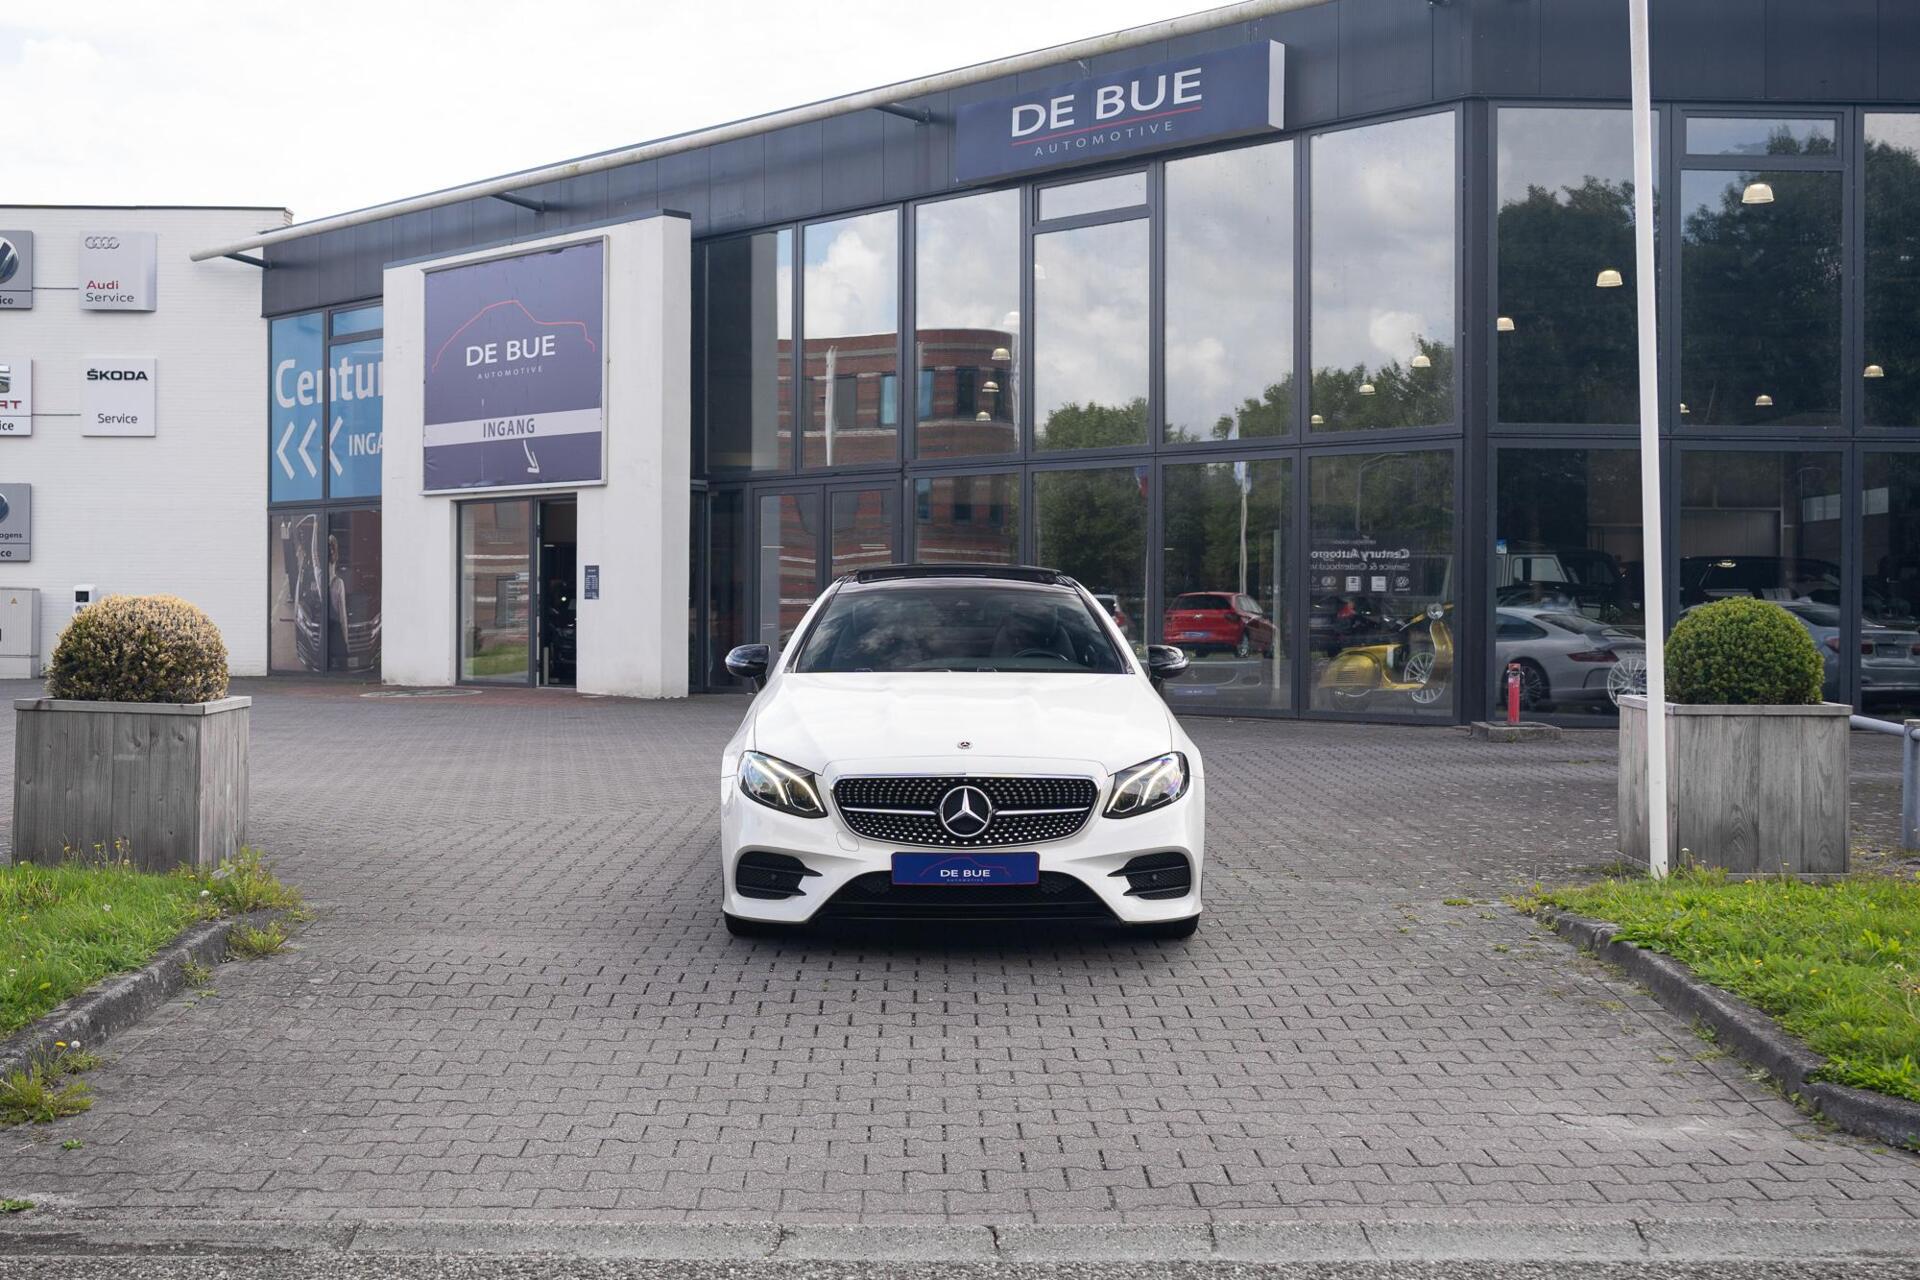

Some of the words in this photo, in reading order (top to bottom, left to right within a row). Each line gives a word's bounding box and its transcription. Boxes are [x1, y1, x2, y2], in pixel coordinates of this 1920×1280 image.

[1011, 94, 1075, 138] DE
[1095, 67, 1202, 120] BUE
[1034, 121, 1173, 157] AUTOMOTIVE
[86, 280, 119, 290] Audi
[85, 292, 135, 303] Service
[466, 343, 498, 367] DE
[506, 335, 556, 361] BUE
[86, 368, 148, 381] ŠKODA
[478, 365, 542, 380] AUTOMOTIVE
[97, 413, 138, 424] Service
[483, 418, 535, 438] INGANG
[940, 869, 959, 877] DE
[963, 869, 991, 877] BUE
